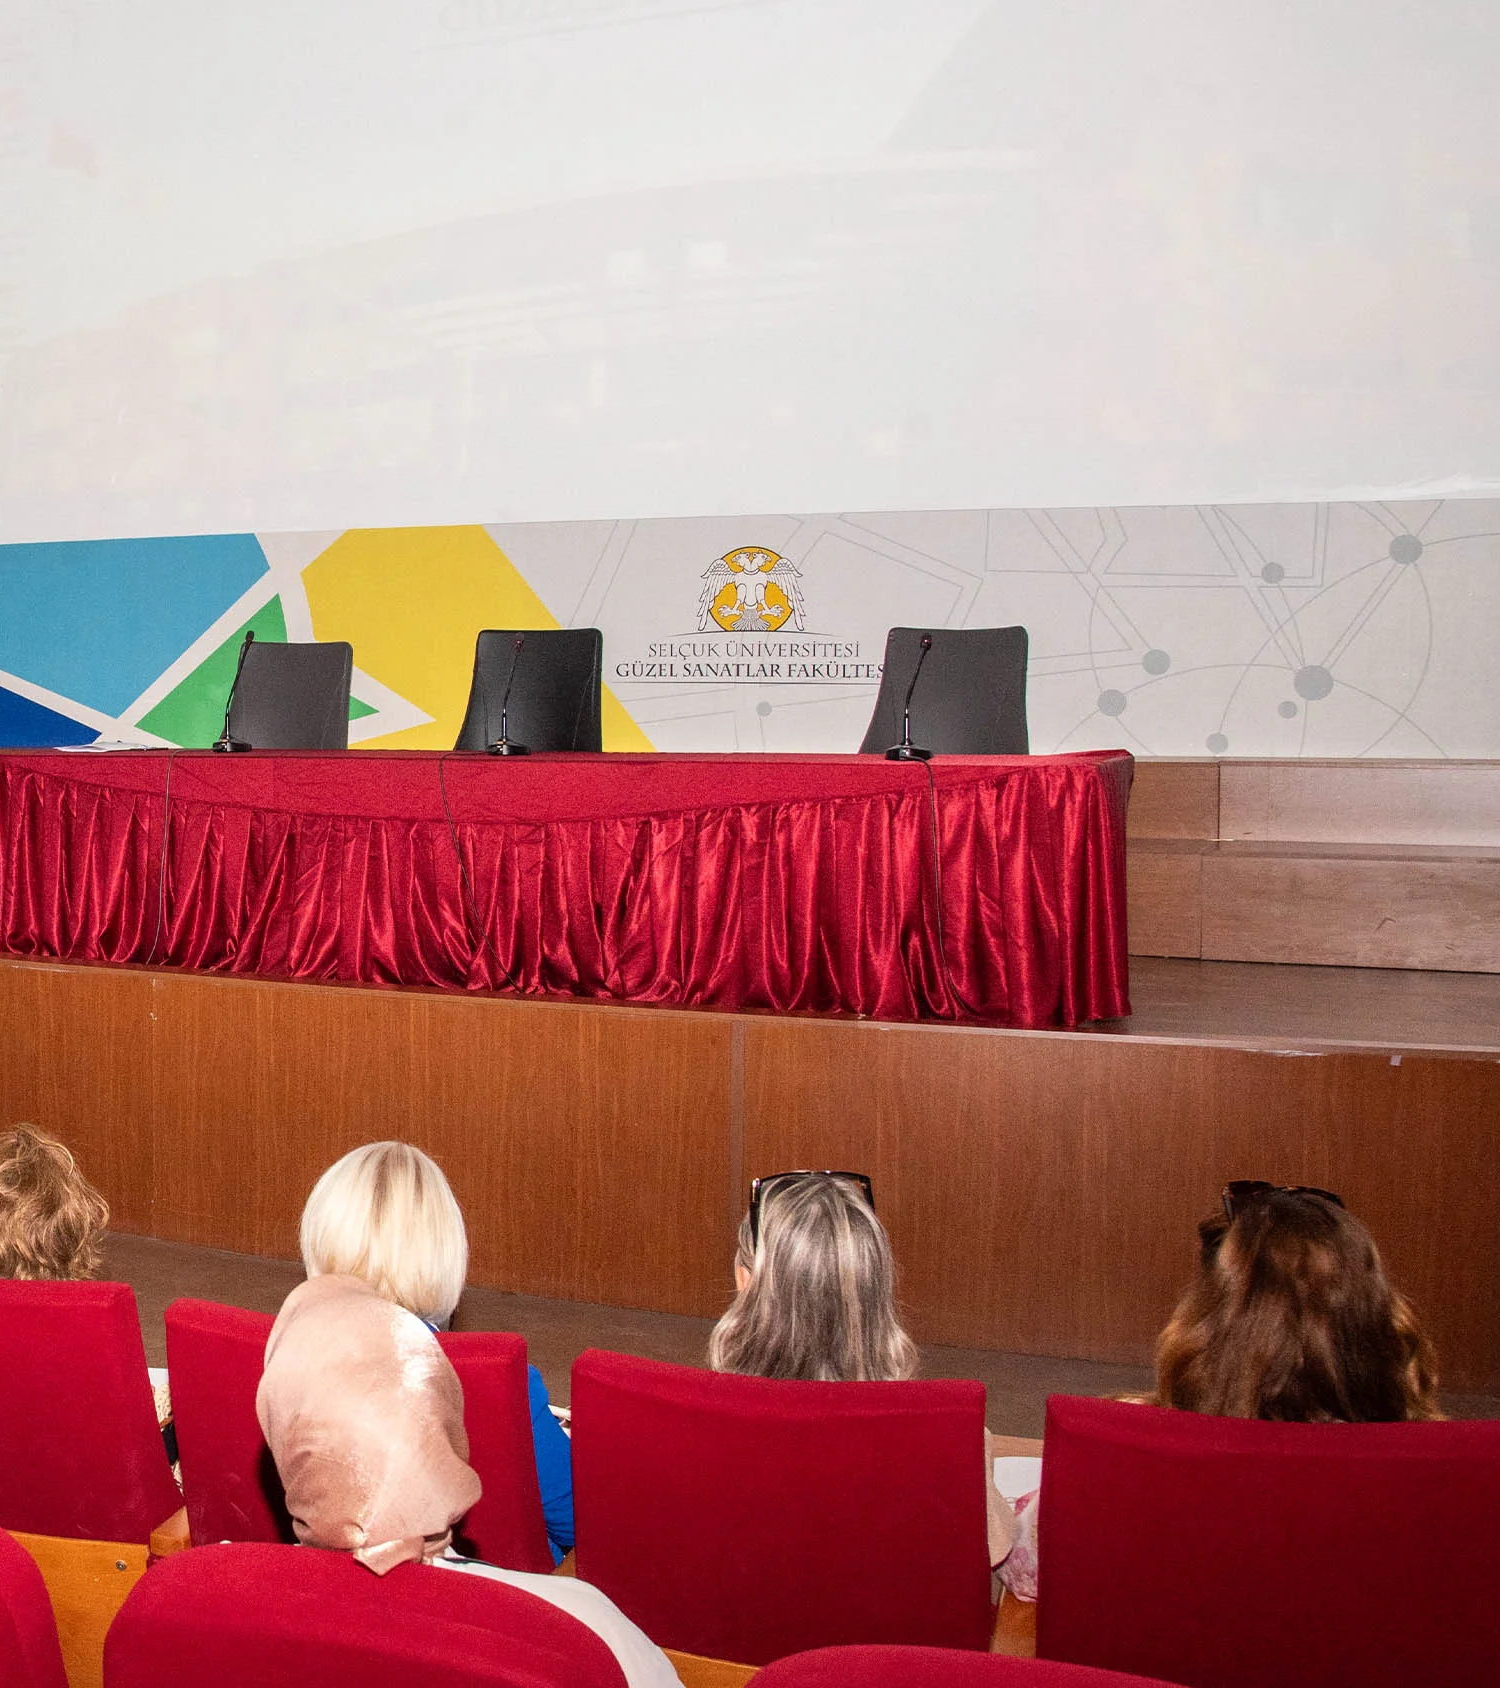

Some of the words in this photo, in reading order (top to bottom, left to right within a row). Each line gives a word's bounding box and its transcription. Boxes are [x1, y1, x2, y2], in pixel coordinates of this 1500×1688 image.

[648, 642, 722, 660] SELÇUK
[726, 640, 860, 658] ÜNİVERSİTESİ
[615, 661, 678, 678] GÜZEL
[681, 663, 781, 678] SANATLAR
[787, 661, 884, 678] FAKÜLTES
